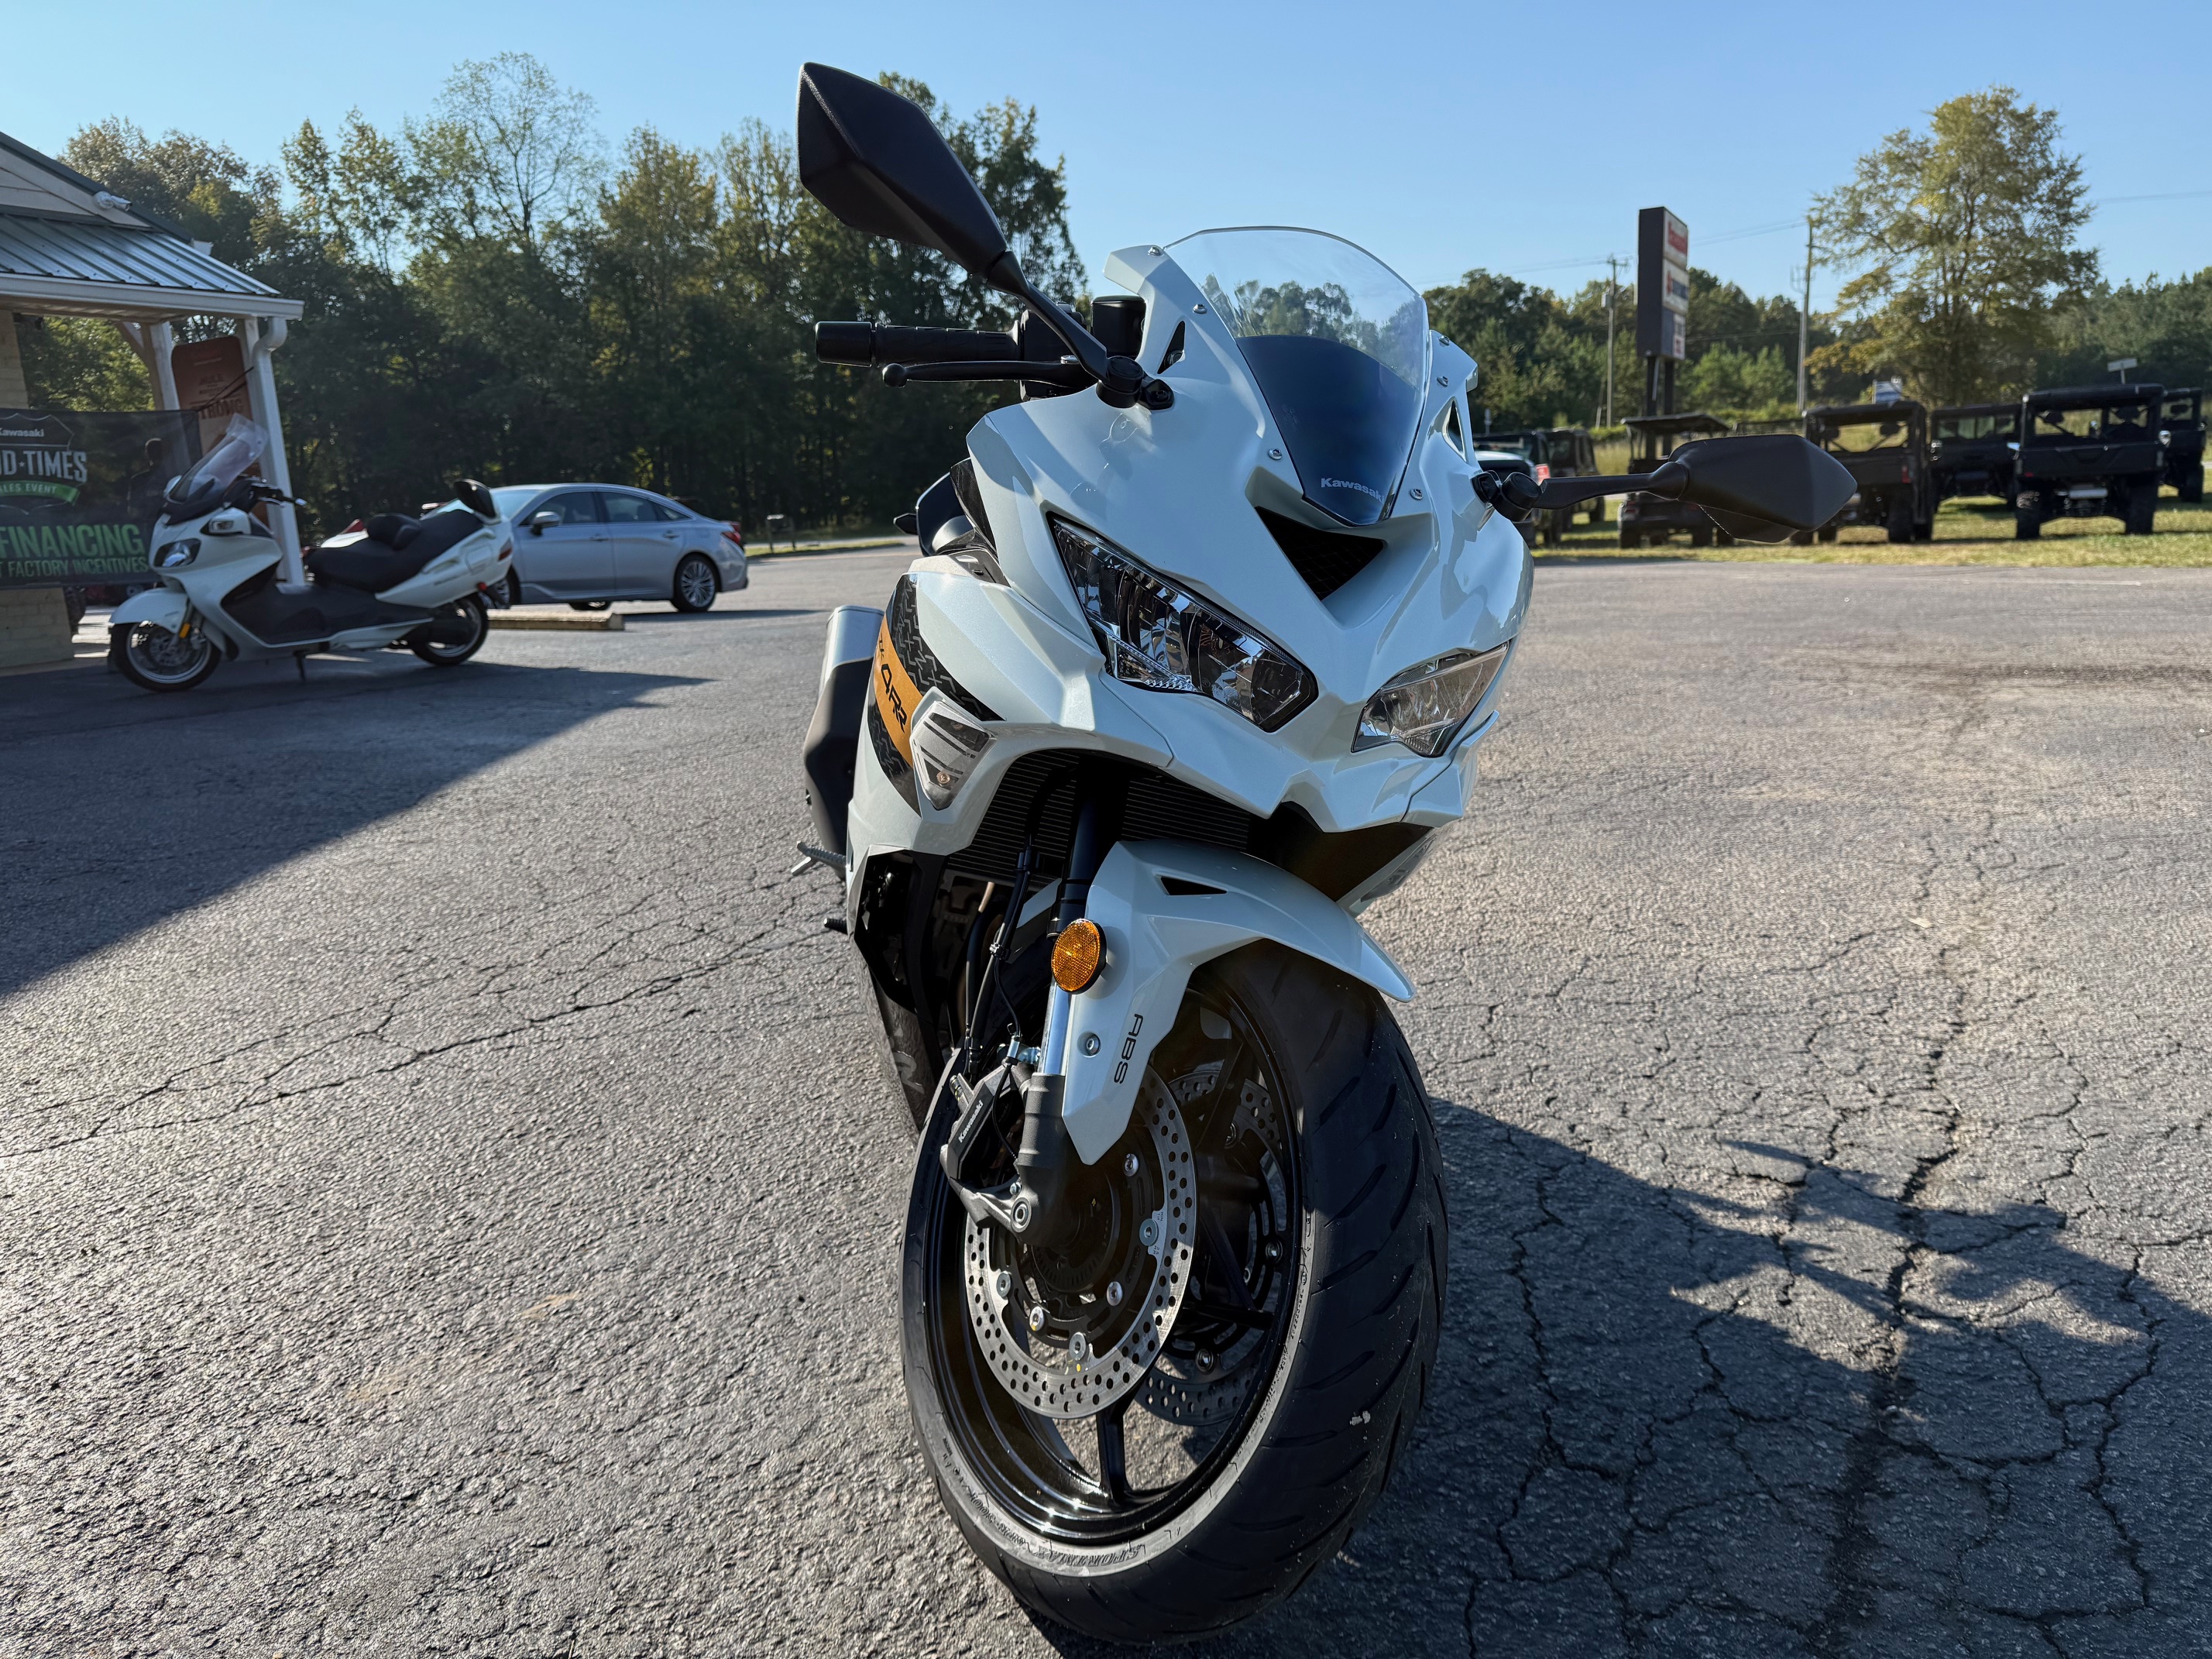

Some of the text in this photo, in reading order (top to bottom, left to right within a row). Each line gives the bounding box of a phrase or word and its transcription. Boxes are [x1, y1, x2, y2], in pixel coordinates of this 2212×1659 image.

[23, 450, 88, 483] TIMES
[26, 483, 57, 494] EVENT
[1321, 477, 1386, 504] Kawasaki
[0, 524, 146, 558] FINANCING
[8, 560, 69, 578] FACTORY
[73, 556, 149, 575] INCENTIVES
[1114, 1013, 1143, 1084] ABS
[958, 1100, 984, 1143] Kawasaki
[1032, 1543, 1143, 1568] SPORTMAX
